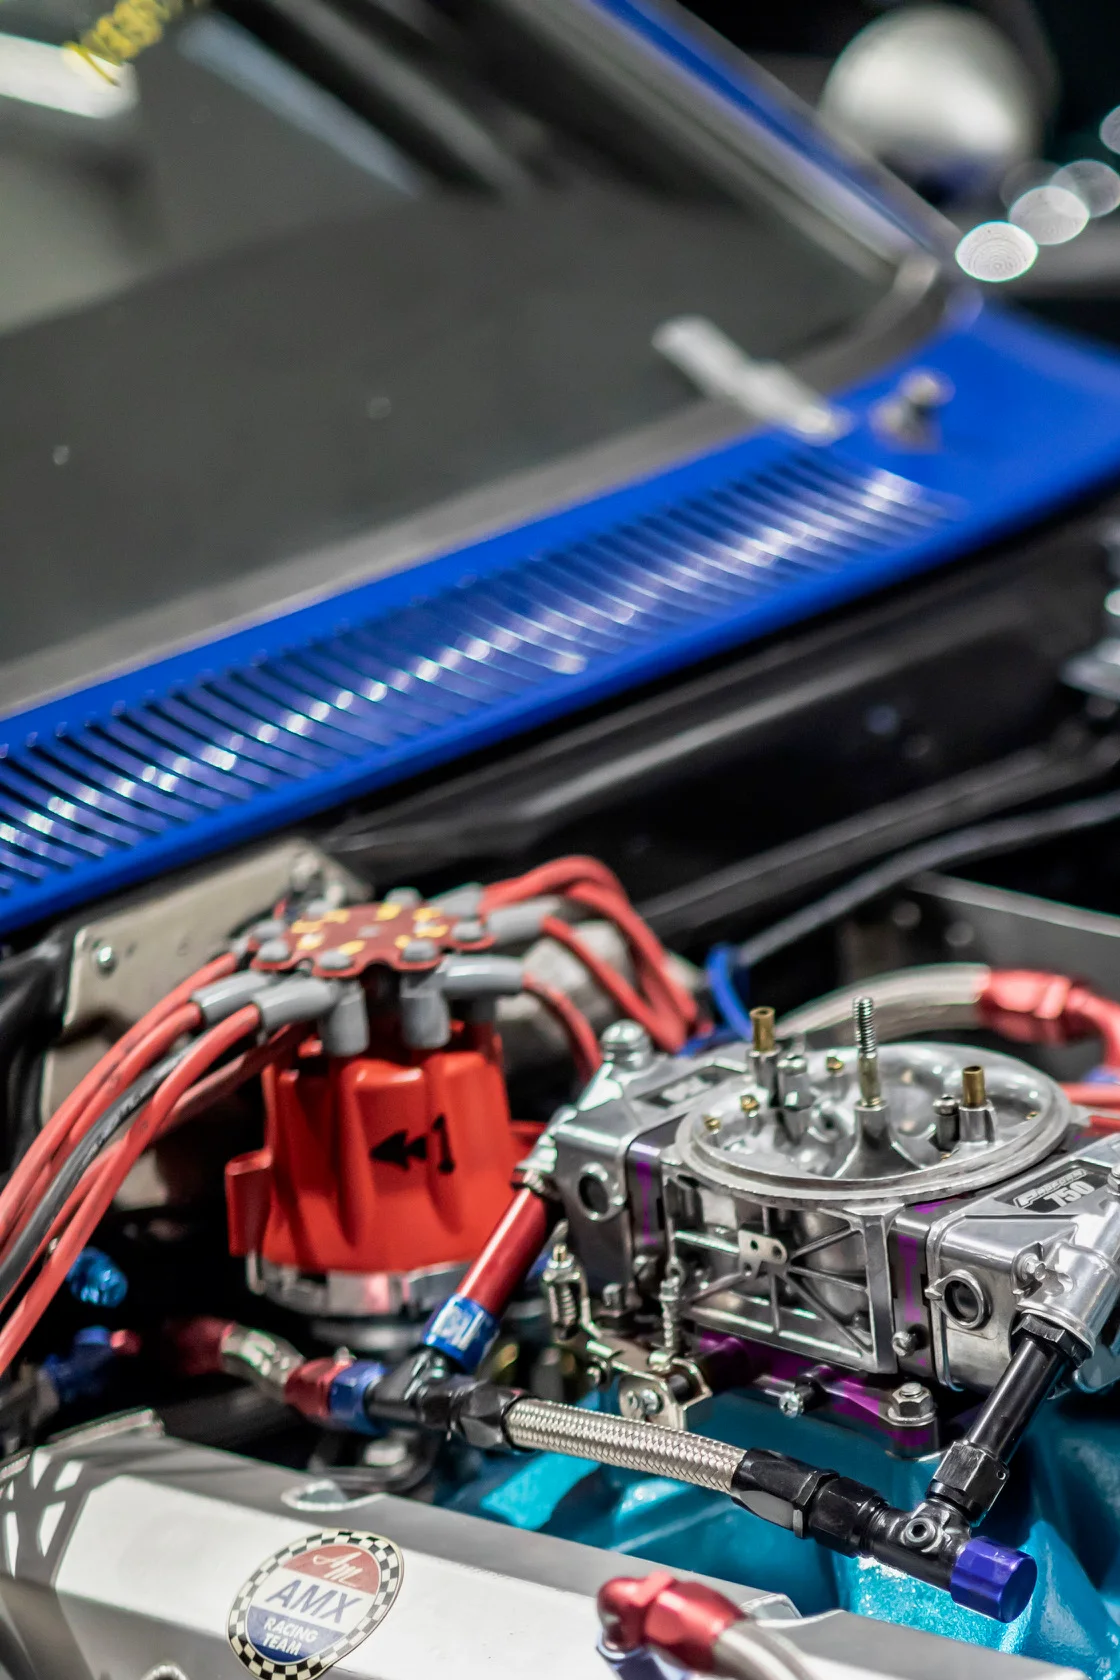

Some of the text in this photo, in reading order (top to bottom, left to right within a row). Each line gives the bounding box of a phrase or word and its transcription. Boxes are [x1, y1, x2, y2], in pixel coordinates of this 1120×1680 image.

[432, 1113, 455, 1176] 1
[1043, 1181, 1096, 1208] 750
[264, 1579, 363, 1624] AMX
[263, 1617, 319, 1643] RACING
[262, 1632, 302, 1656] TEAM
